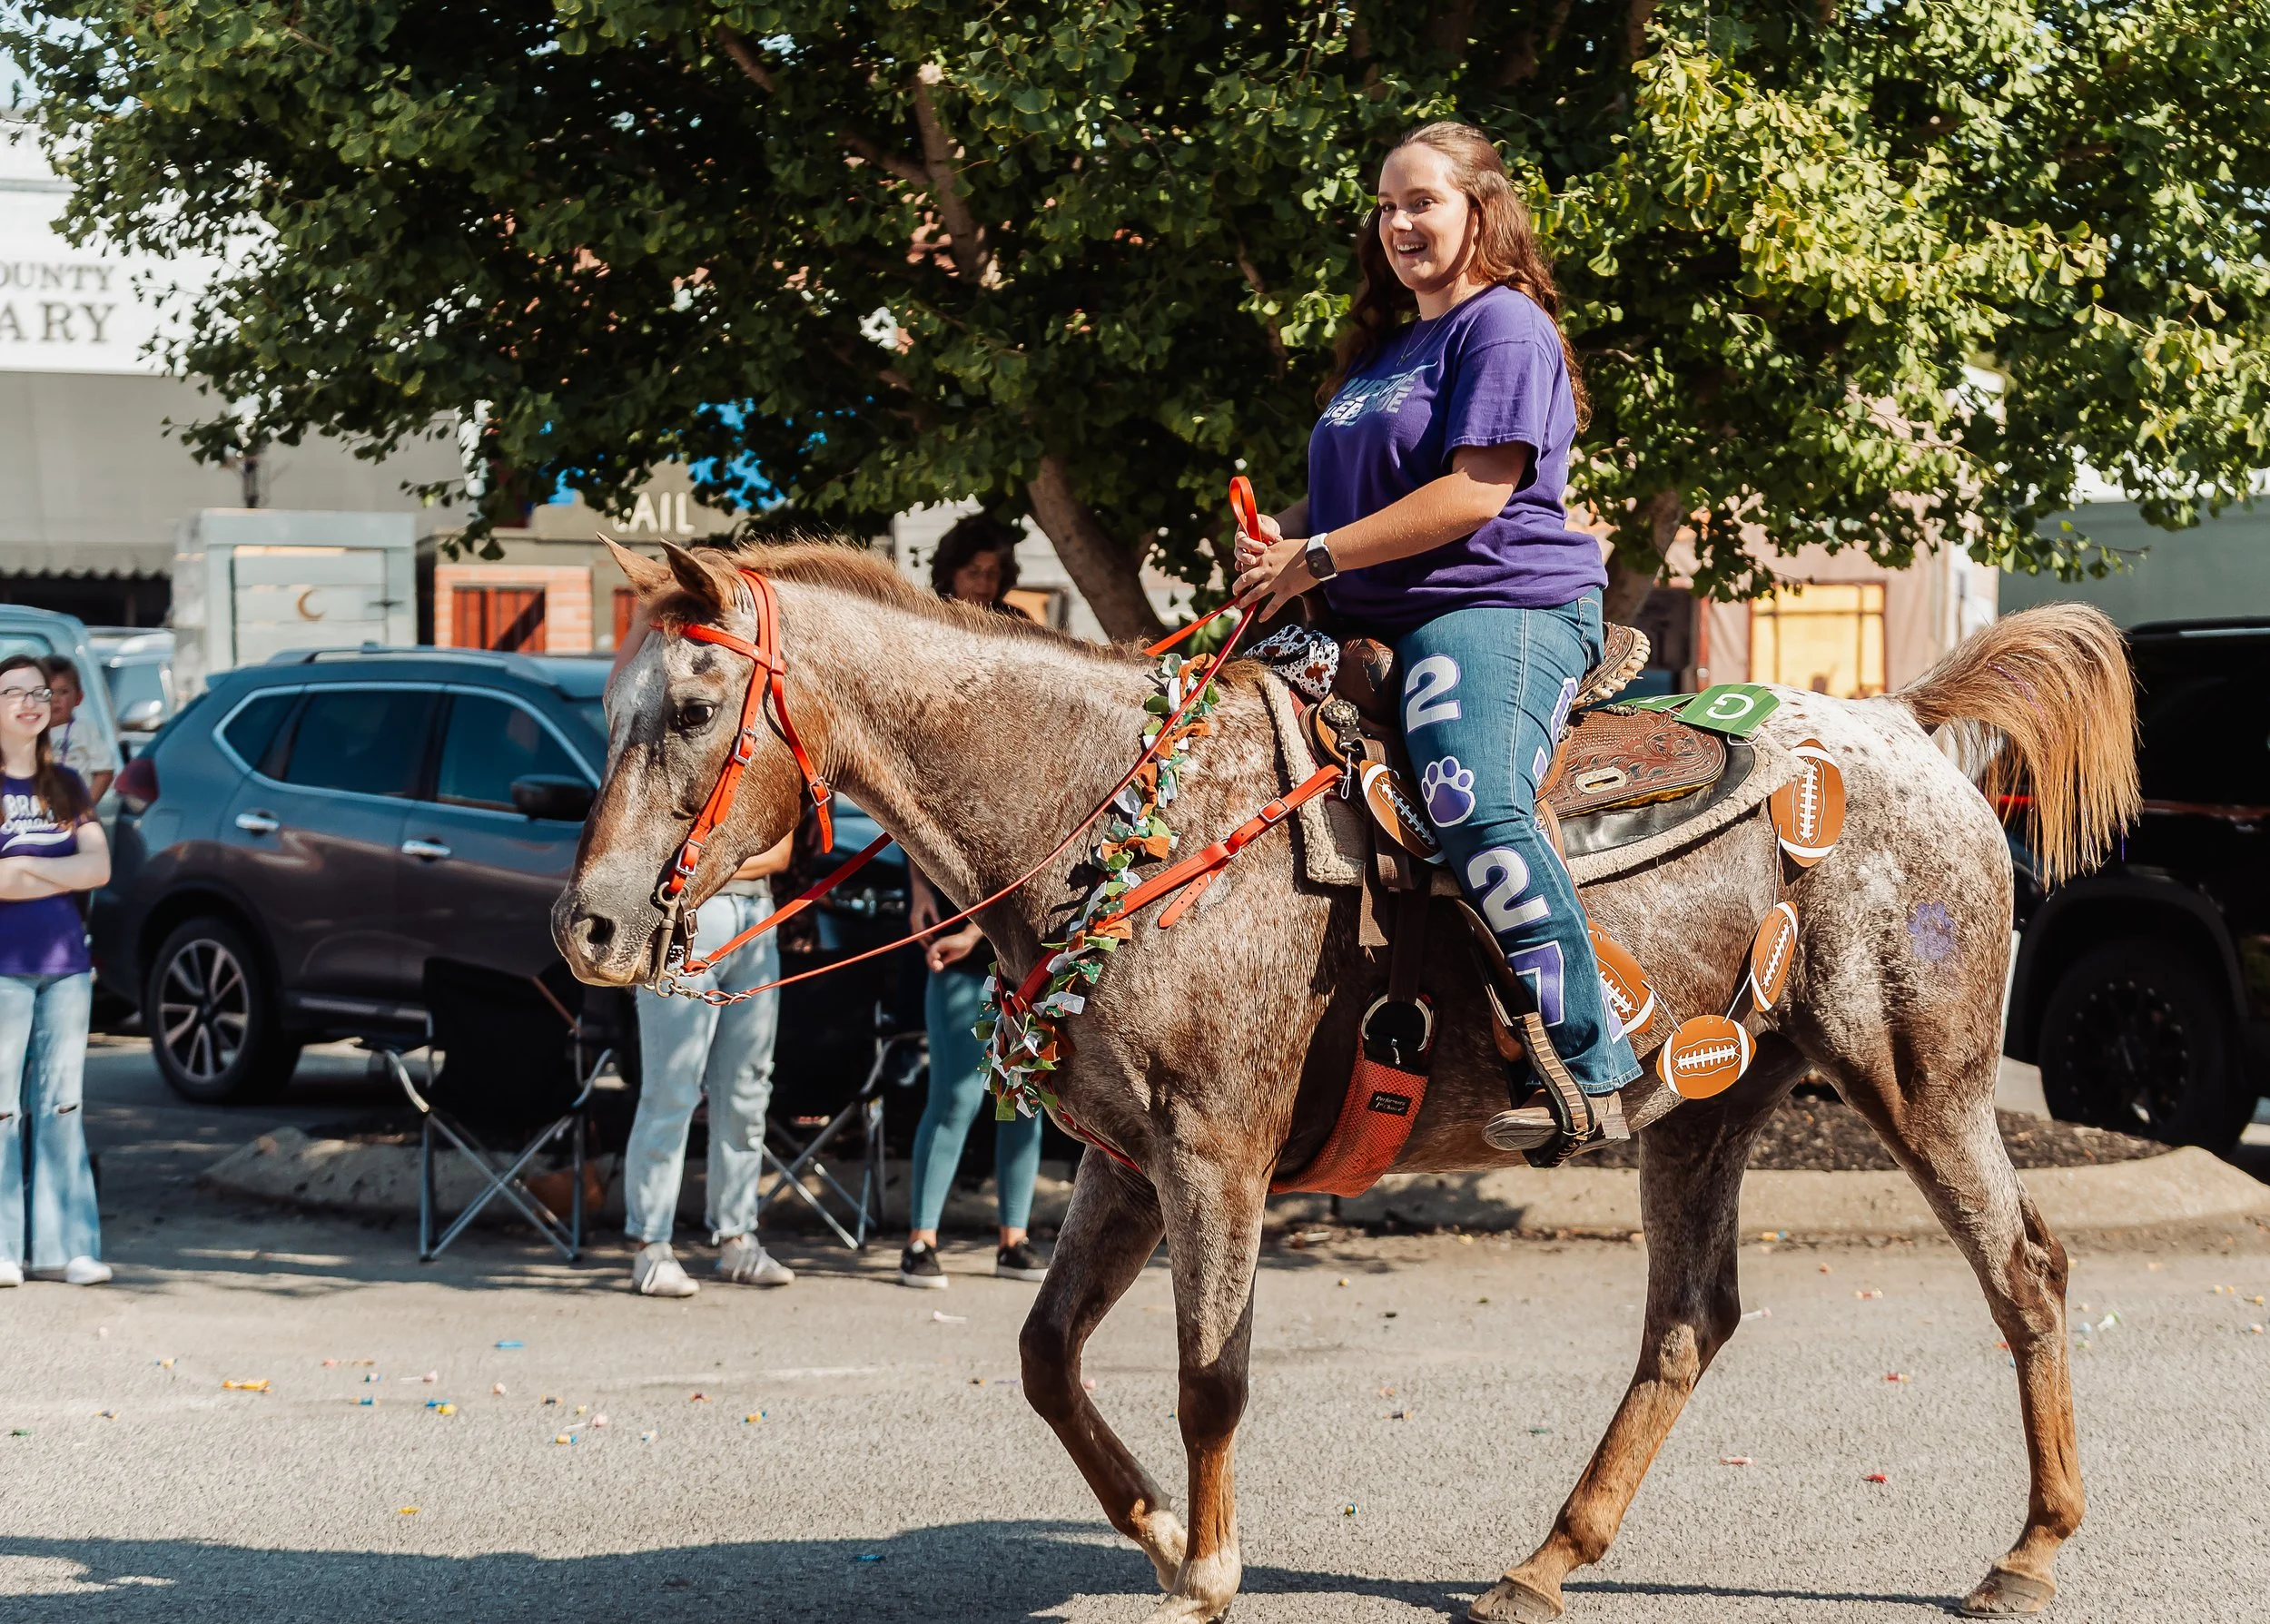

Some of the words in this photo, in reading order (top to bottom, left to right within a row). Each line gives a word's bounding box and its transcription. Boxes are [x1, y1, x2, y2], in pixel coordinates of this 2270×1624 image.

[0, 300, 118, 342] ARY
[1405, 653, 1461, 733] 2
[1466, 845, 1551, 933] 2
